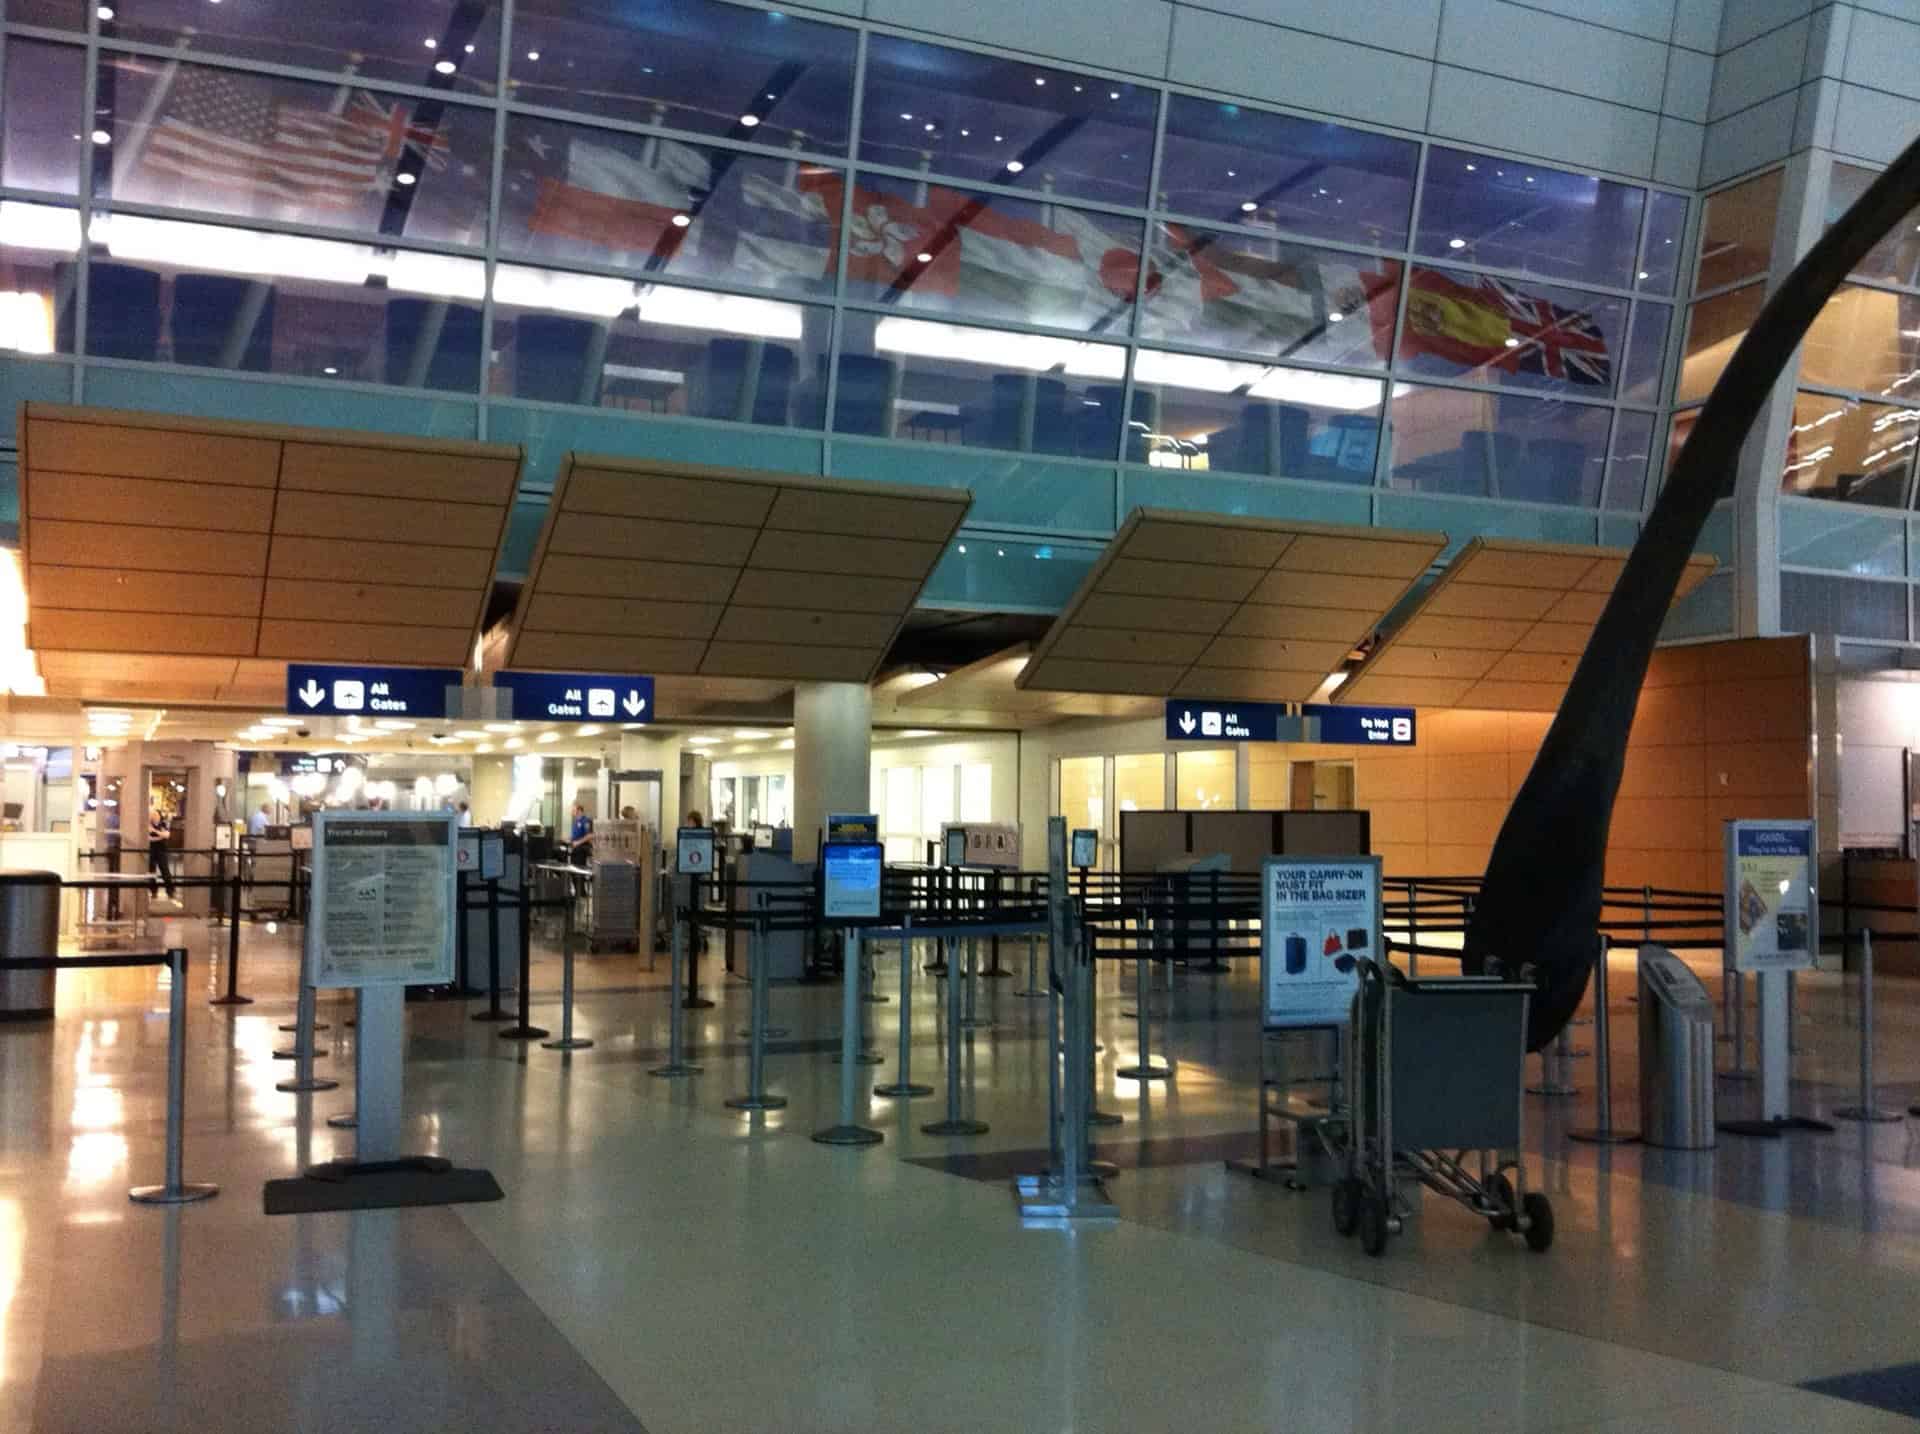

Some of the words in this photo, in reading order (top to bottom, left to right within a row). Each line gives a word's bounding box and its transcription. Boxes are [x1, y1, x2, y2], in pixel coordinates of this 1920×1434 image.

[371, 682, 389, 695] All
[565, 689, 582, 701] All
[371, 698, 407, 710] Gates
[548, 702, 582, 716] Gates
[1225, 713, 1238, 724] All
[1361, 717, 1373, 728] Do
[1374, 717, 1389, 728] Not
[1225, 725, 1250, 737] Gates
[1368, 729, 1389, 740] Enter
[1277, 870, 1306, 880] YOUR
[1309, 870, 1363, 880] CARRY-ON
[1276, 880, 1305, 889] MUST
[1308, 880, 1325, 889] FIT
[1276, 890, 1287, 900] IN
[1290, 889, 1310, 900] THE
[1312, 889, 1334, 900] BAG
[1335, 889, 1366, 900] SIZER
